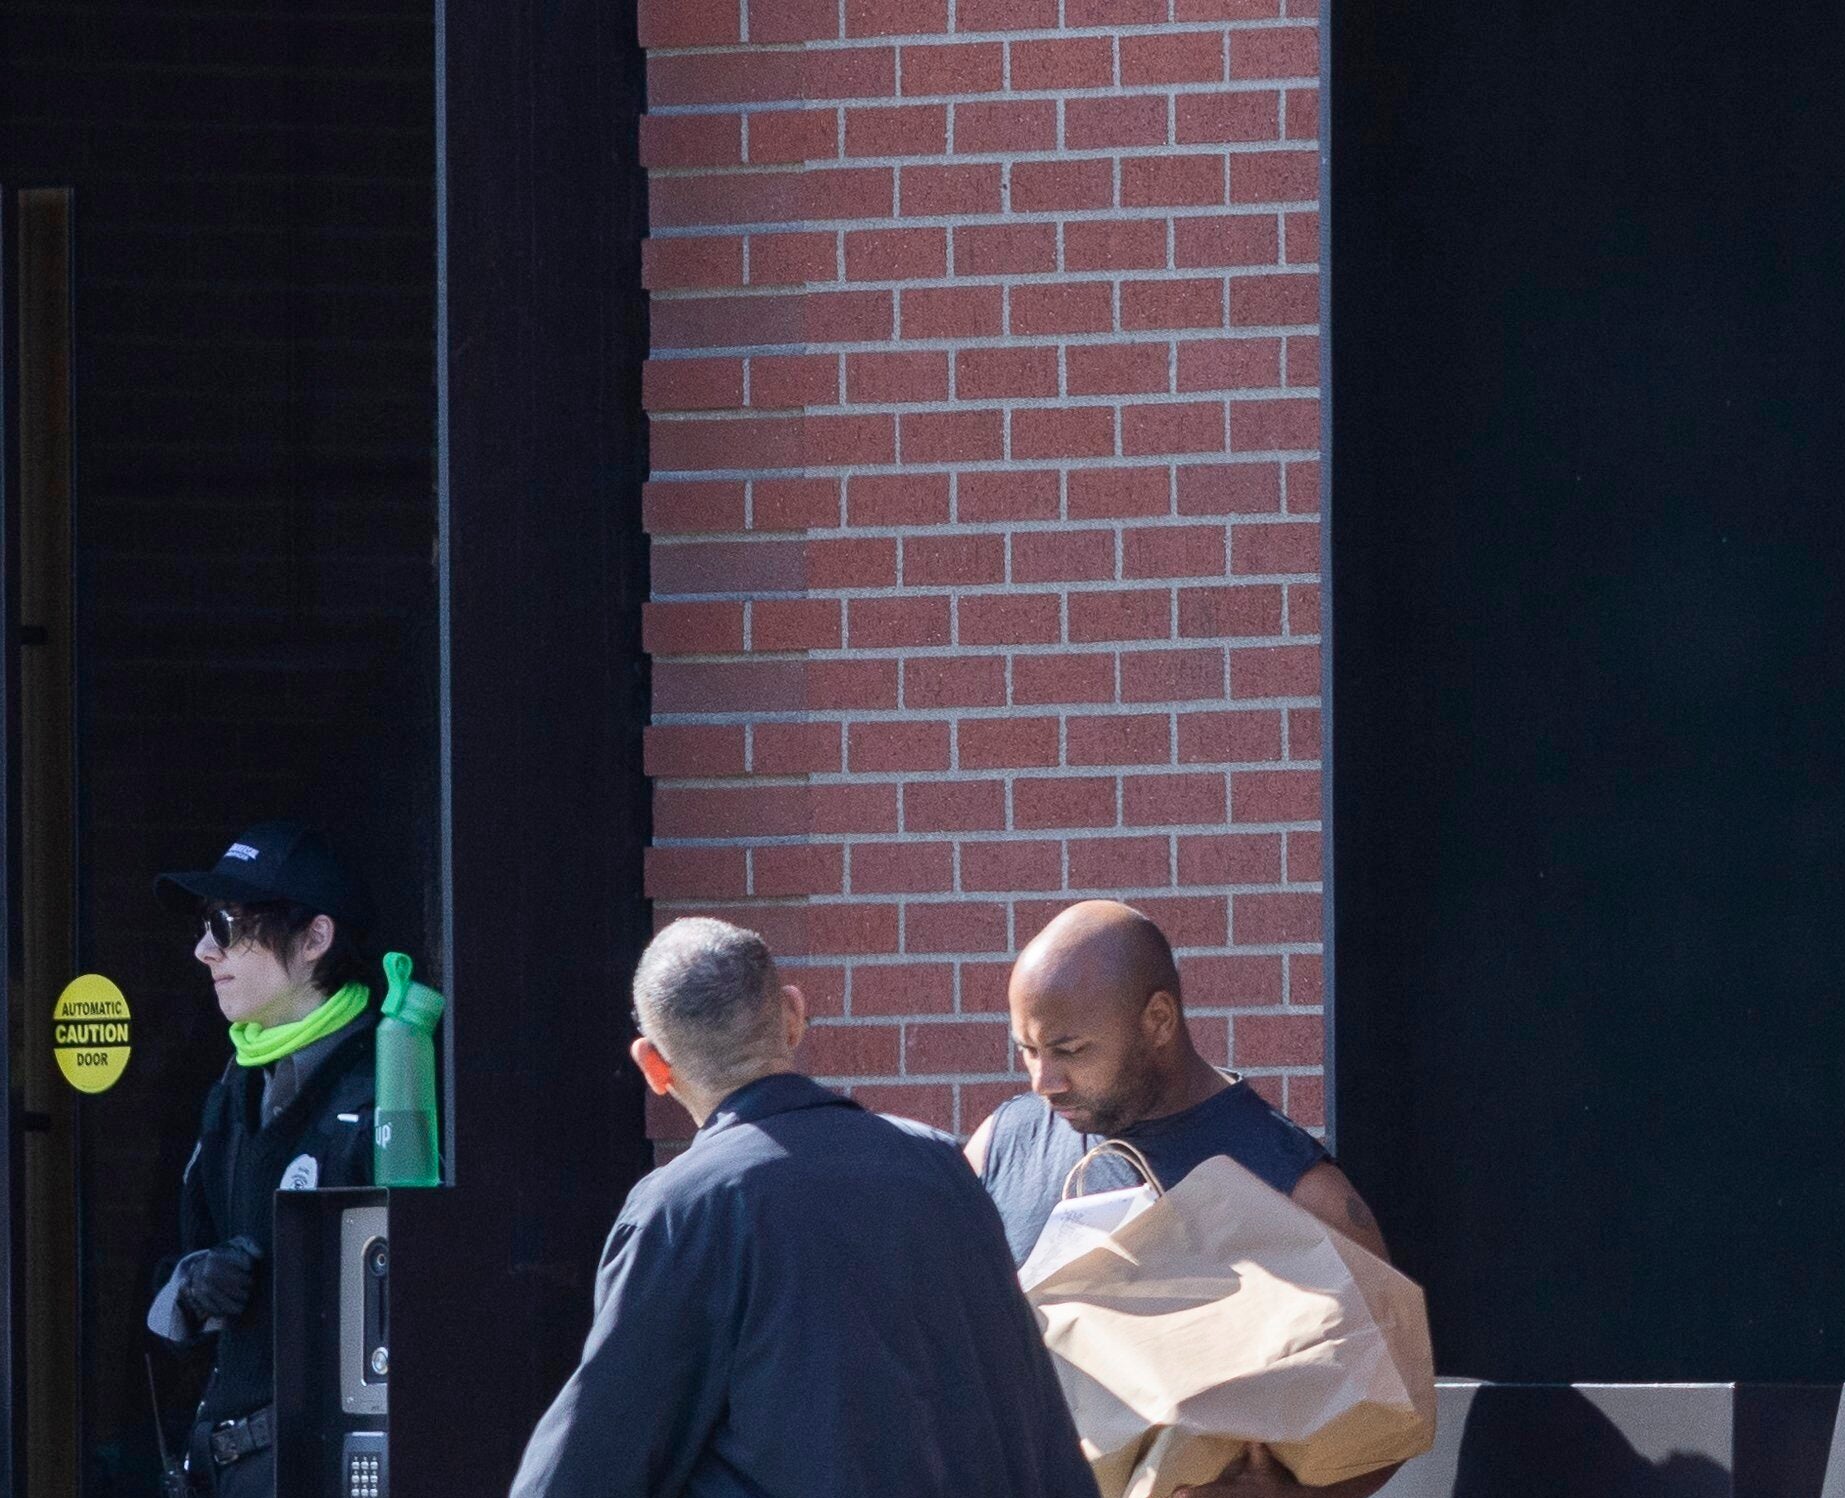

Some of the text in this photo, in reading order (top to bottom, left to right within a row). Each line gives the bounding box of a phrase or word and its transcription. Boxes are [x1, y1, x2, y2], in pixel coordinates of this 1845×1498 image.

[62, 1001, 122, 1016] AUTOMATIC
[55, 1023, 129, 1043] CAUTION
[77, 1053, 108, 1067] DOOR
